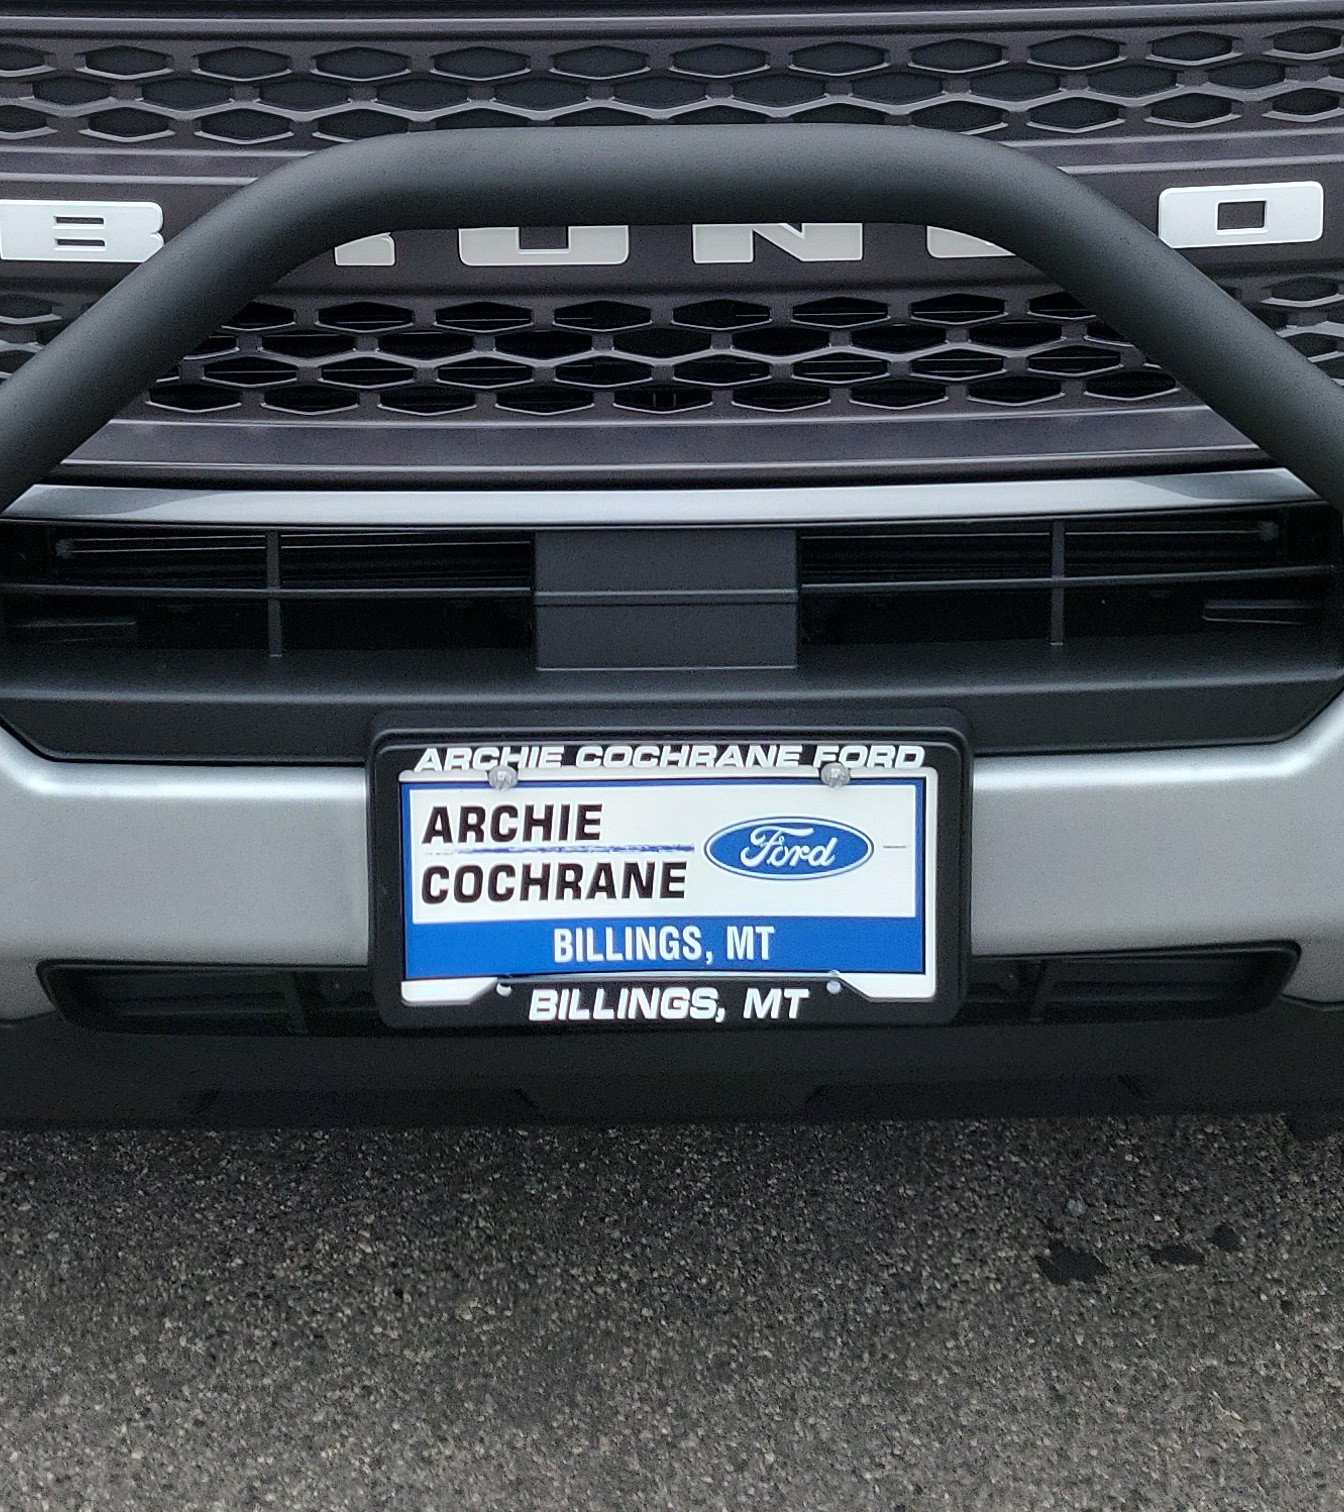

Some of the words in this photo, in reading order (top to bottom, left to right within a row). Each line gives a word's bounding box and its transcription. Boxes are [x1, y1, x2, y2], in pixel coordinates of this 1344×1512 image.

[413, 746, 565, 773] ARCHIE
[575, 744, 803, 770] COCHRANE
[813, 744, 926, 770] FORD
[421, 803, 604, 845] ARCHIE
[739, 825, 838, 868] Ford
[421, 861, 688, 905] COCHRANE
[554, 925, 714, 965] BILLINGS,
[726, 925, 775, 961] MT
[528, 986, 726, 1024] BILLINGS,
[743, 987, 811, 1020] MT
